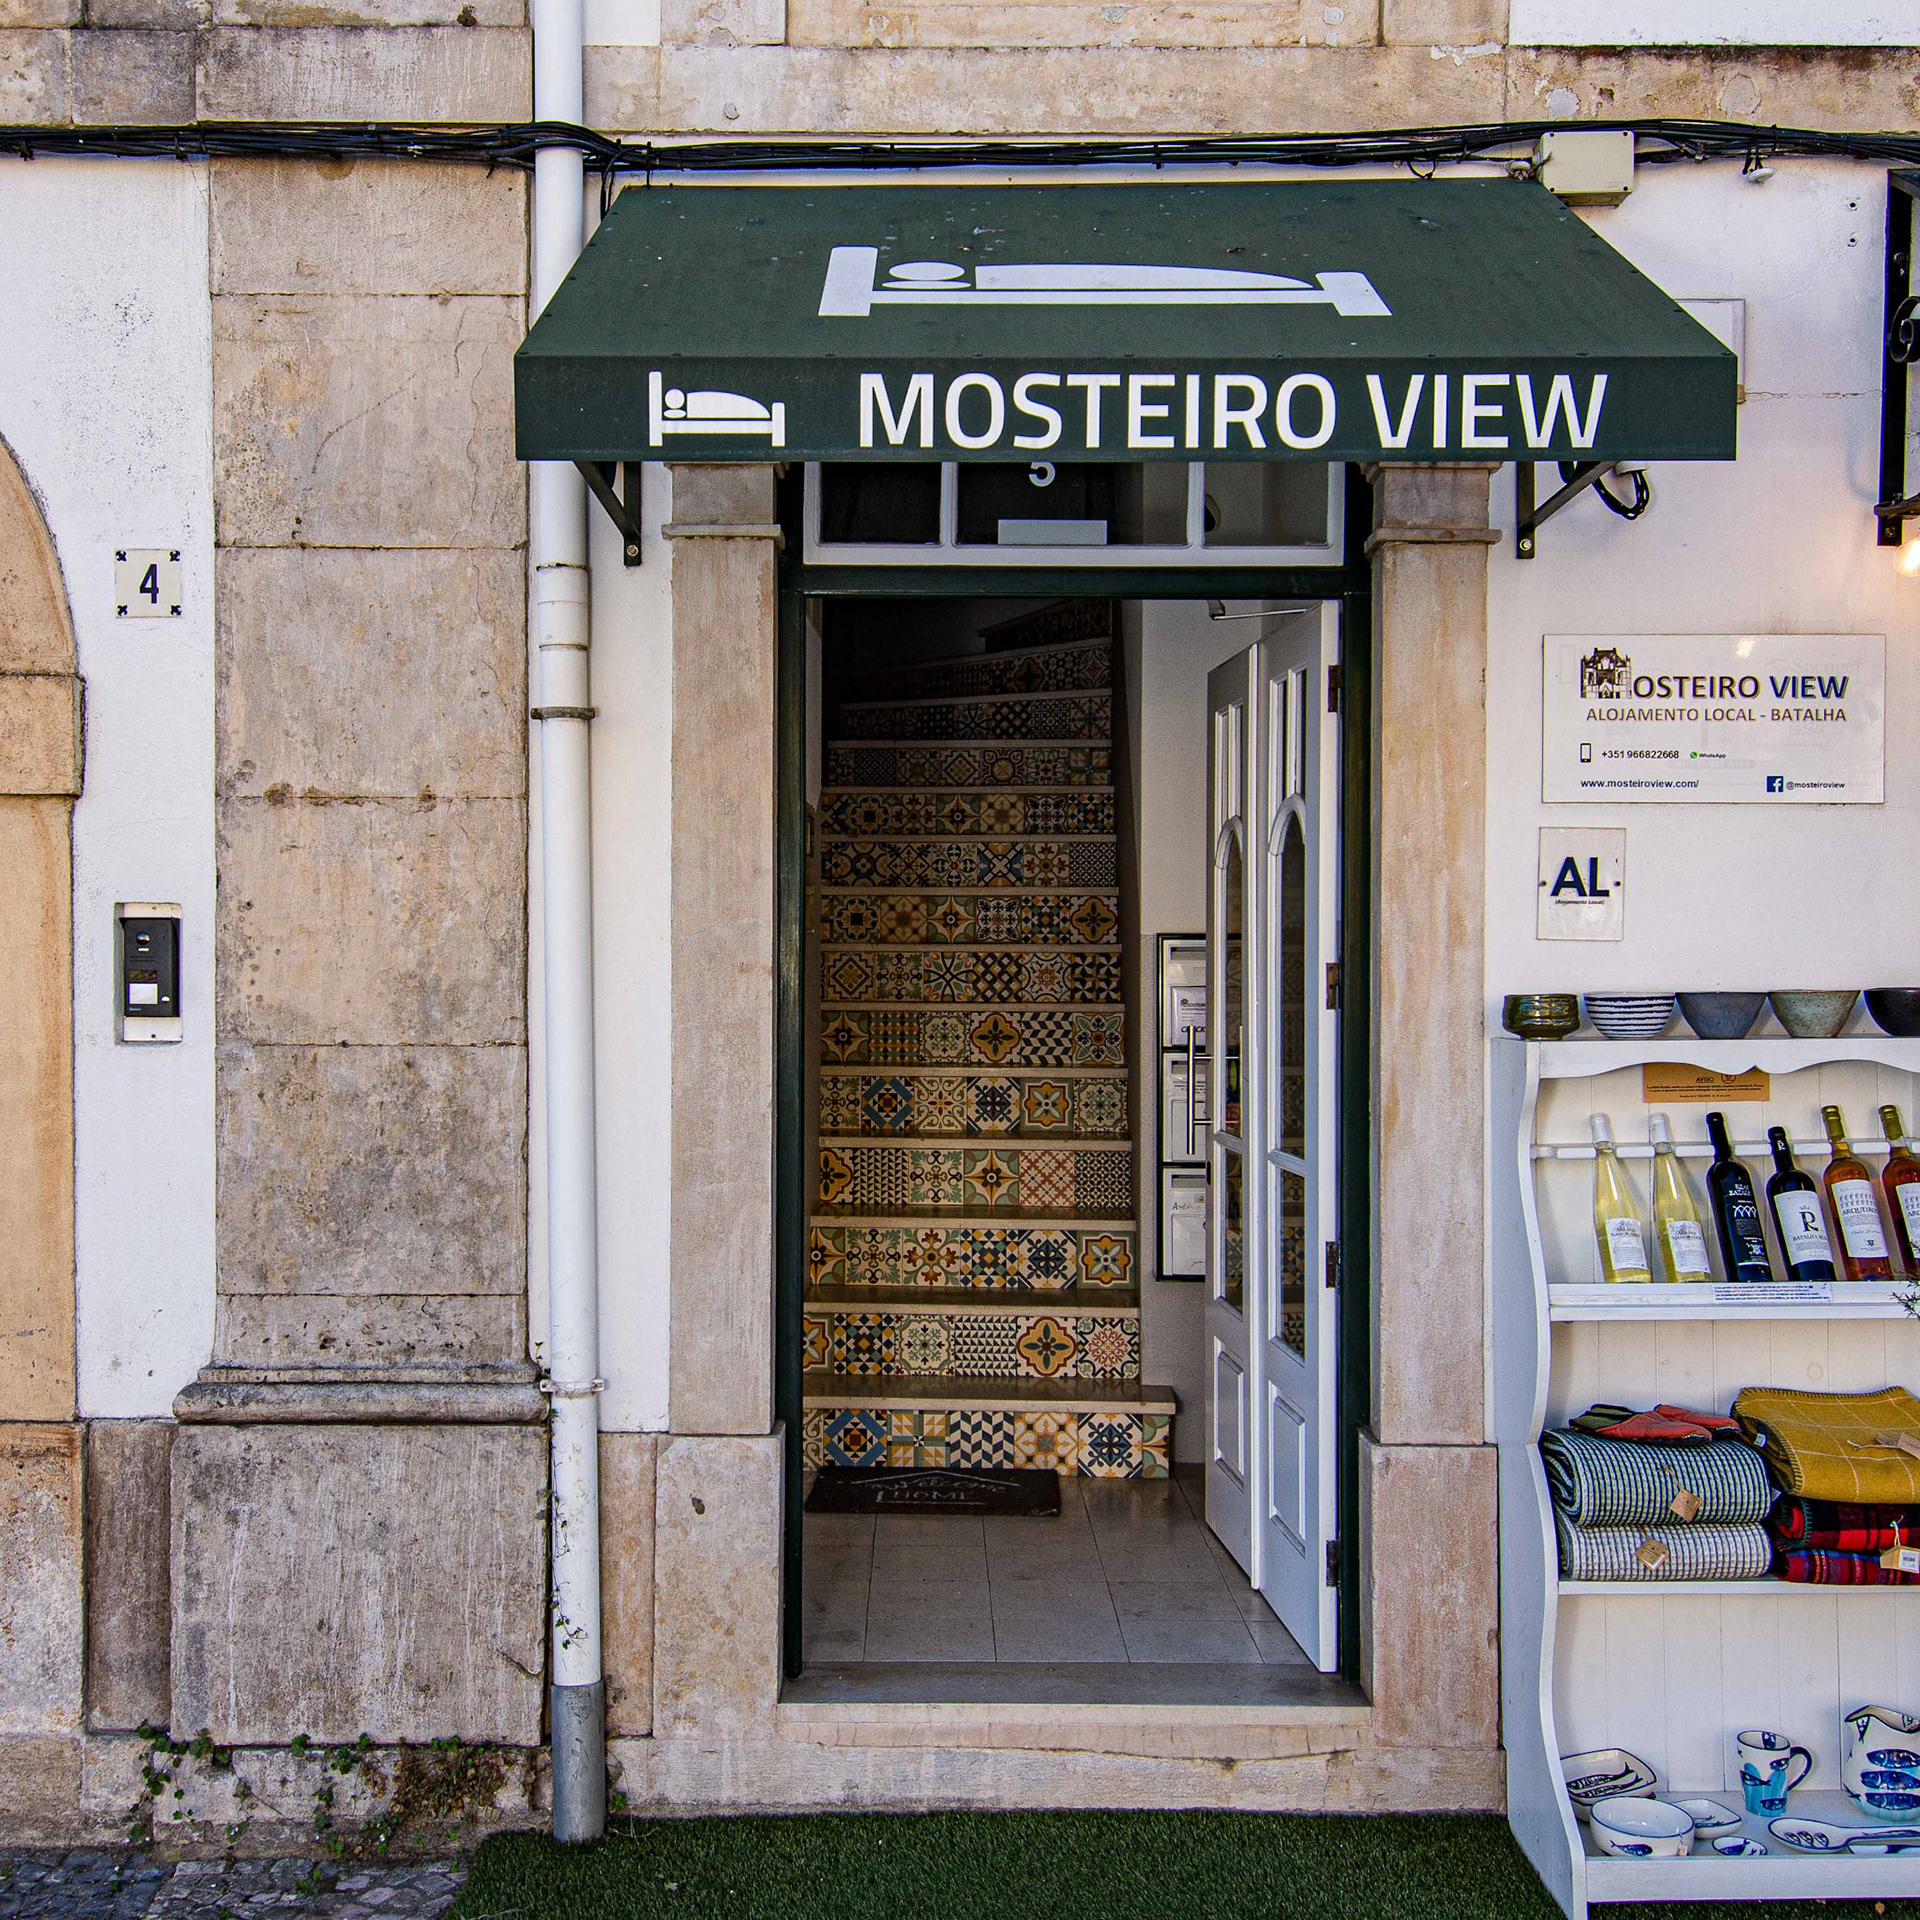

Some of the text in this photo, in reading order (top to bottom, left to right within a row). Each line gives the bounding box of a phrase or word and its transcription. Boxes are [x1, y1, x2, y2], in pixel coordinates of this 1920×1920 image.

[860, 372, 1608, 450] MOSTEIRO VIEW
[1028, 461, 1056, 487] 5
[139, 563, 160, 605] 4
[1769, 675, 1850, 699] VIEW
[1586, 708, 1699, 721] ALOJAMENTO
[1704, 708, 1756, 721] LOCAL
[1771, 708, 1847, 721] BATALHA
[1699, 752, 1727, 760] WhatsApp
[1580, 779, 1700, 788] www.mosteiroview.com/
[1786, 781, 1846, 791] @mosteiroview
[1550, 856, 1611, 897] AL
[1798, 1210, 1819, 1232] R
